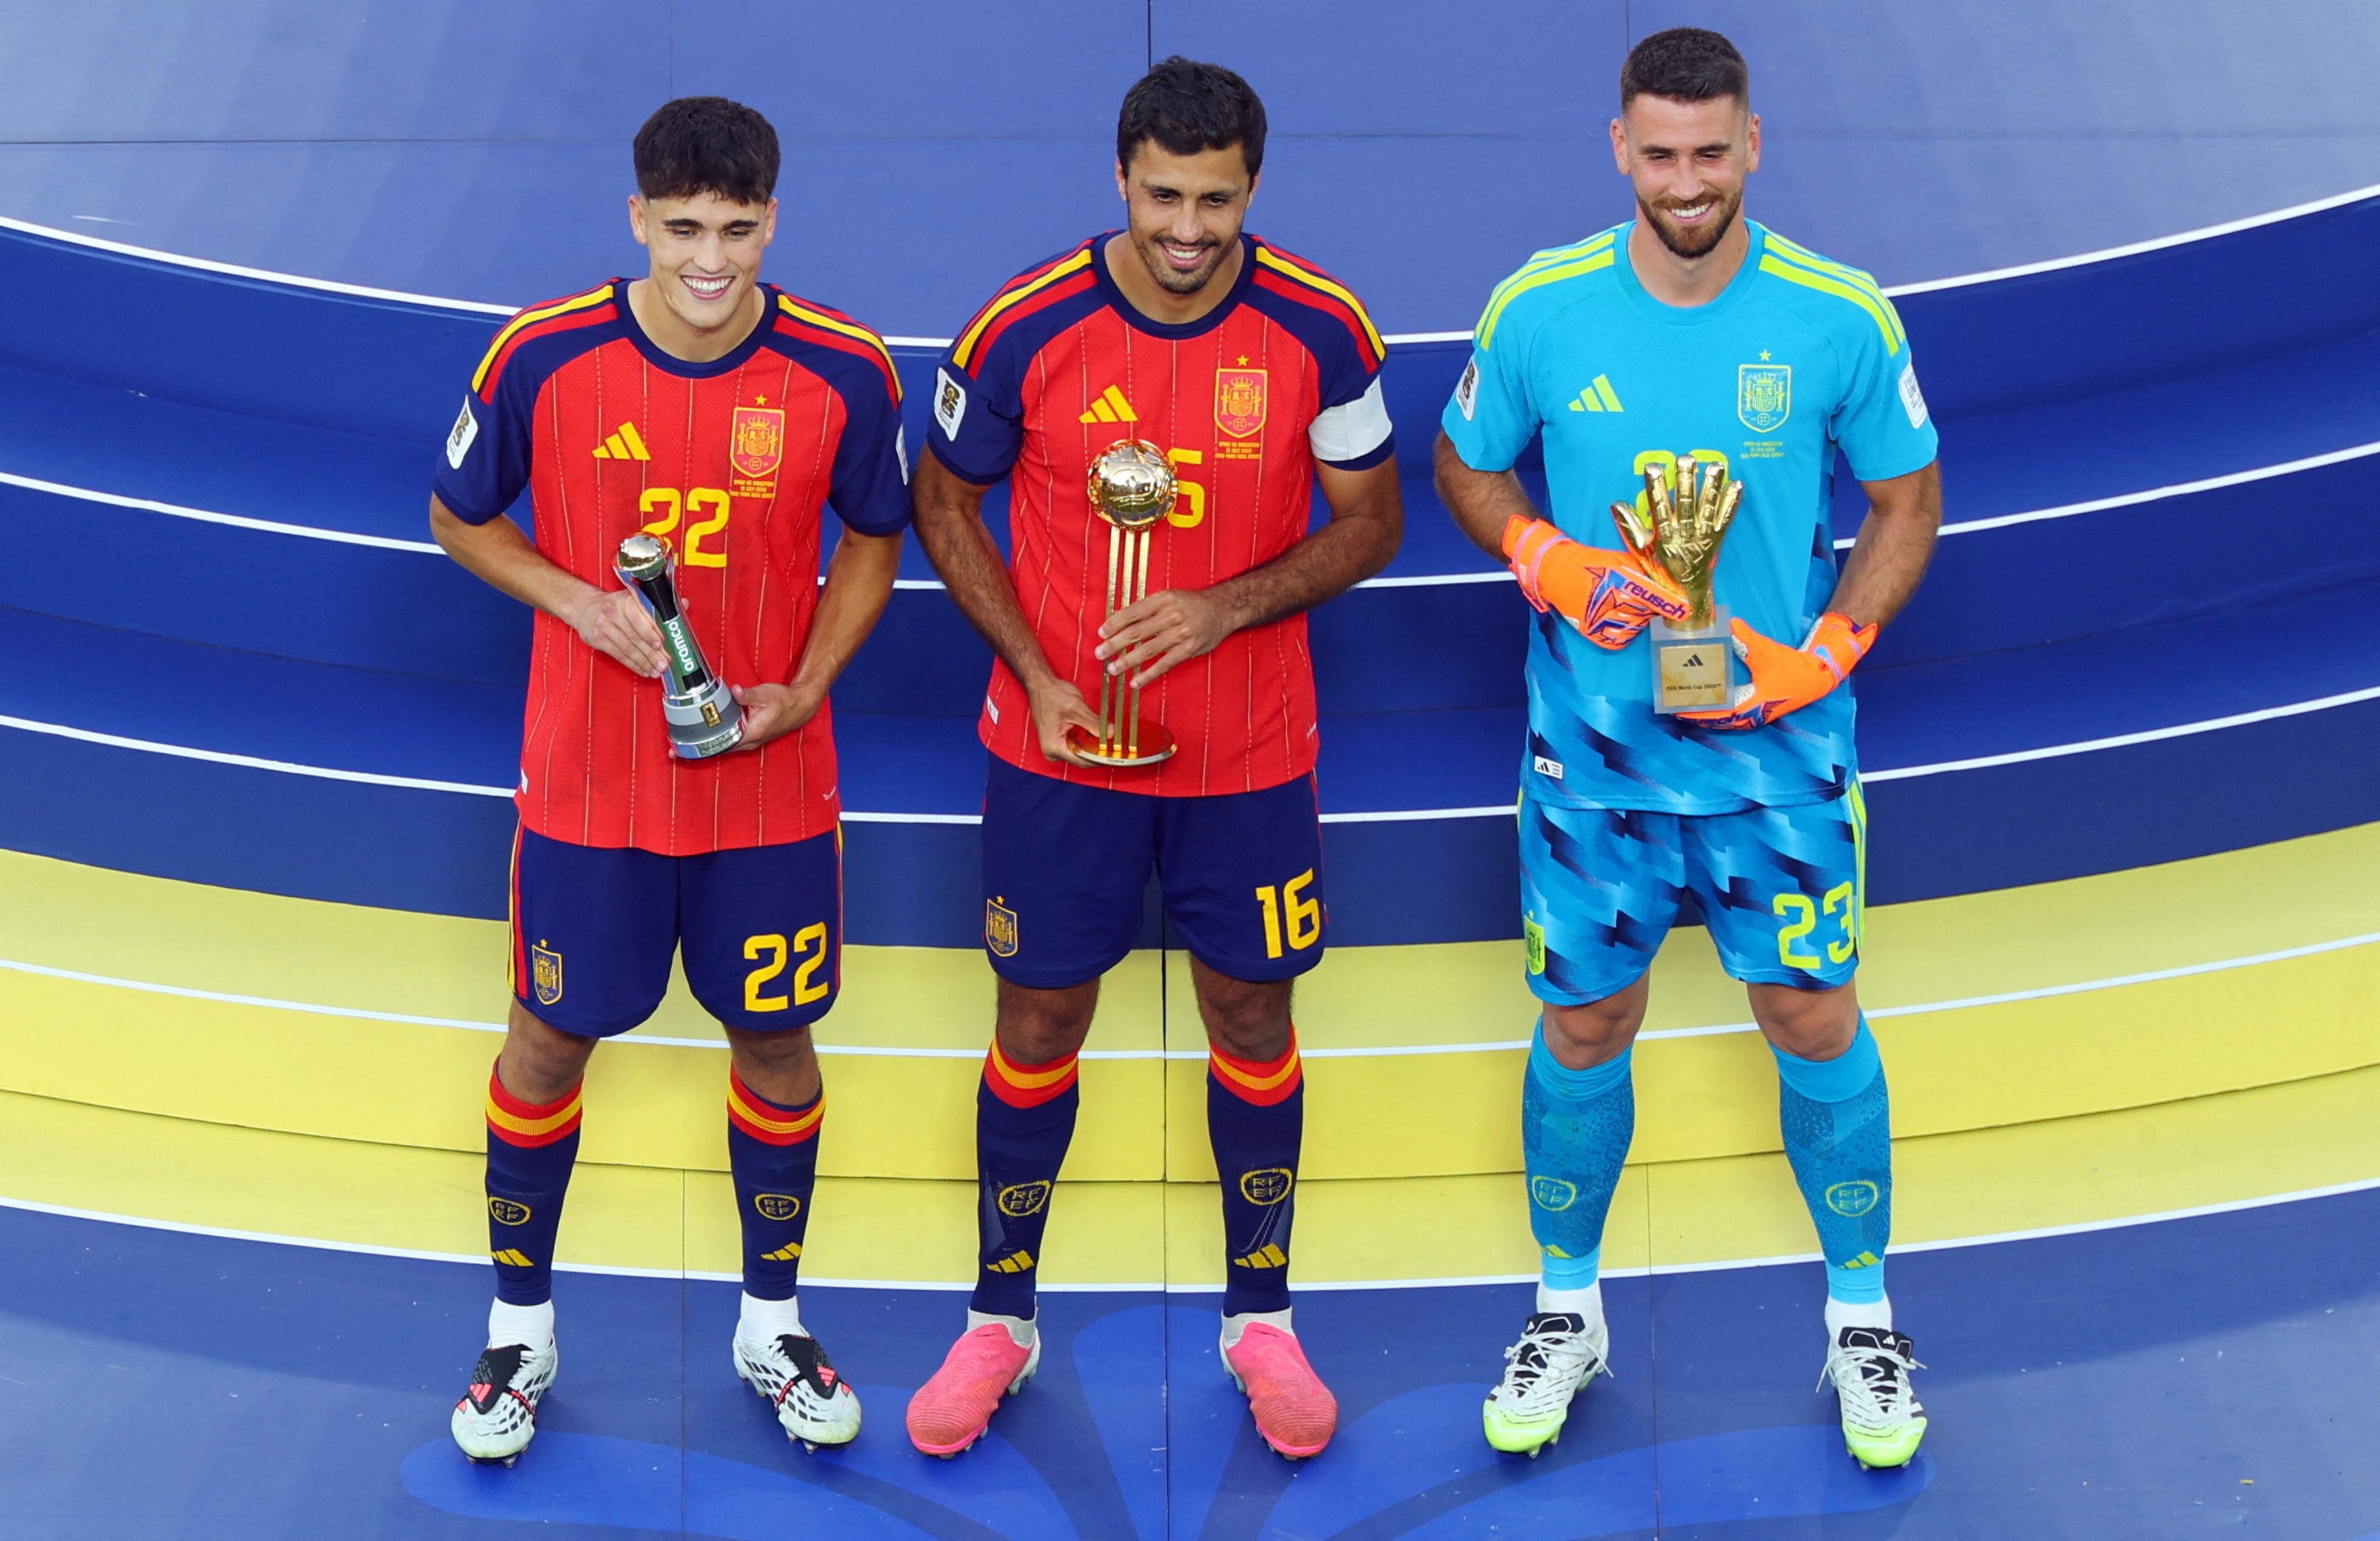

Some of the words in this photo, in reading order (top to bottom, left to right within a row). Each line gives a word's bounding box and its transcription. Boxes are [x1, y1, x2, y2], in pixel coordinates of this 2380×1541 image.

[1624, 581, 1686, 620] reusch
[668, 620, 694, 672] aramco
[1255, 867, 1321, 959] 16
[1772, 881, 1854, 969] 23
[744, 921, 829, 1012] 22
